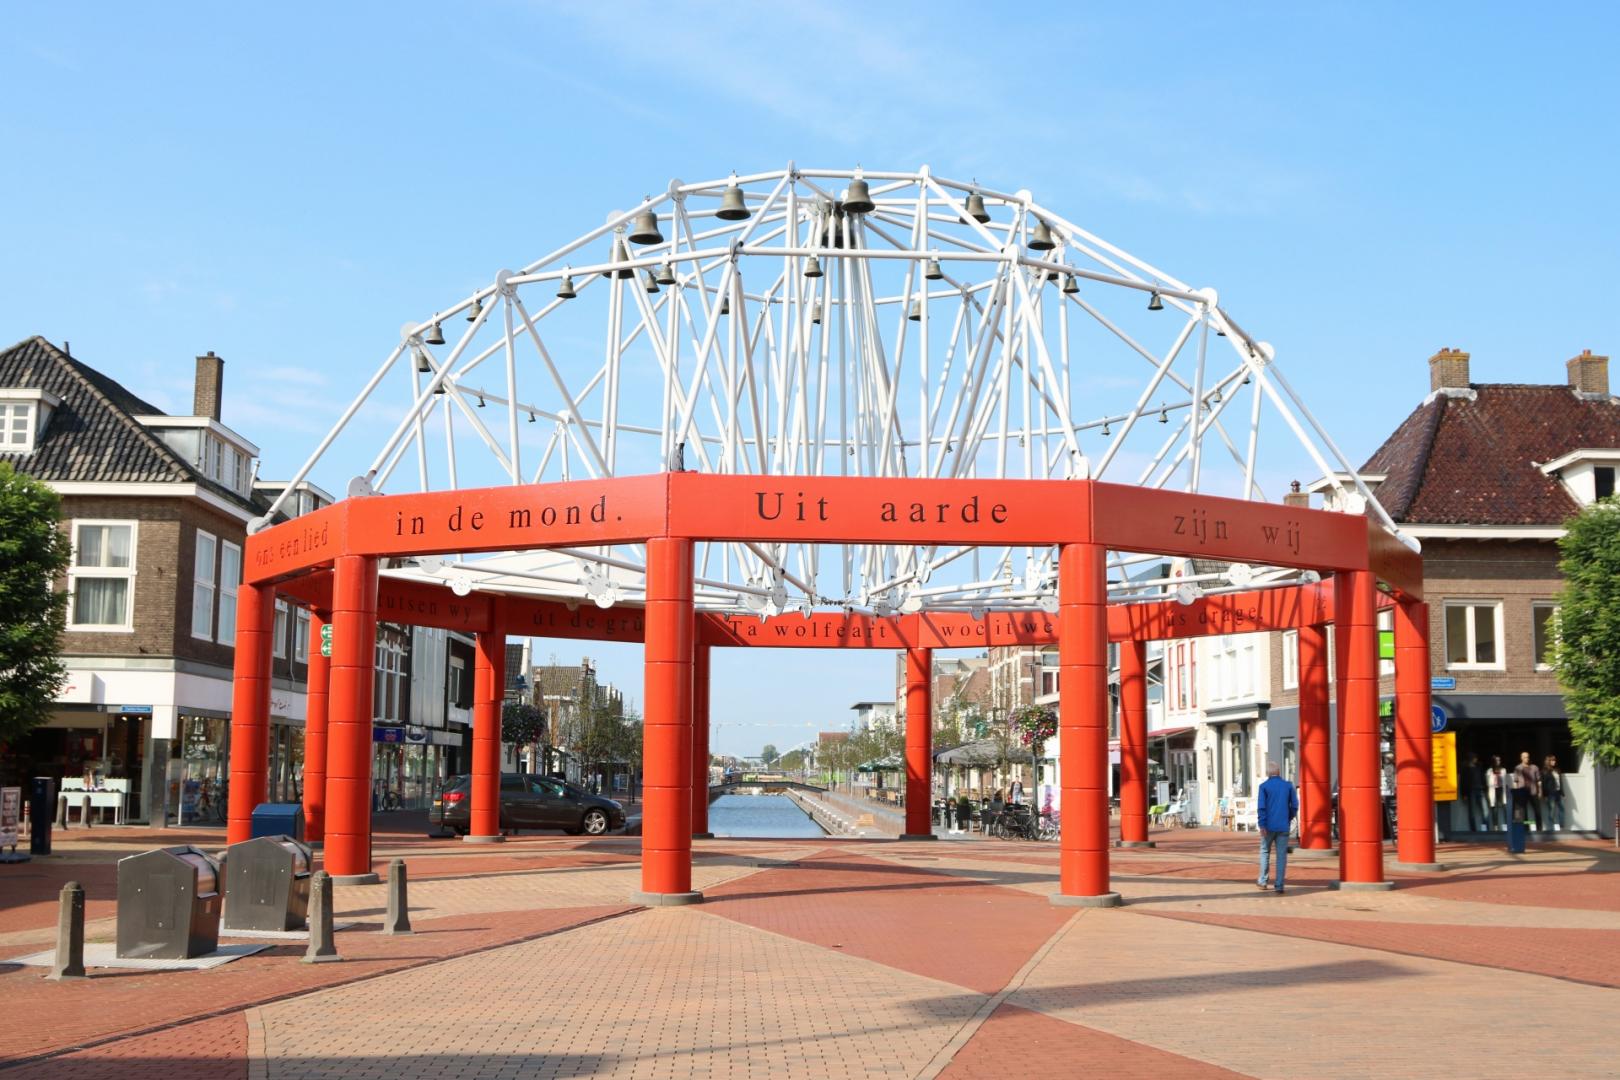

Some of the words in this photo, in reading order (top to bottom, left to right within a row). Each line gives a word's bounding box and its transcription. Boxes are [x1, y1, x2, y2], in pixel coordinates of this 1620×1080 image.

[395, 511, 425, 536] in
[447, 505, 485, 532] de
[508, 495, 623, 529] mond.
[755, 491, 829, 522] Uit
[880, 495, 1009, 524] aarde
[303, 520, 330, 553] lied
[1174, 508, 1229, 545] zijn
[1262, 520, 1301, 556] wij
[728, 620, 758, 638] Ta
[774, 621, 886, 639] wolfeart
